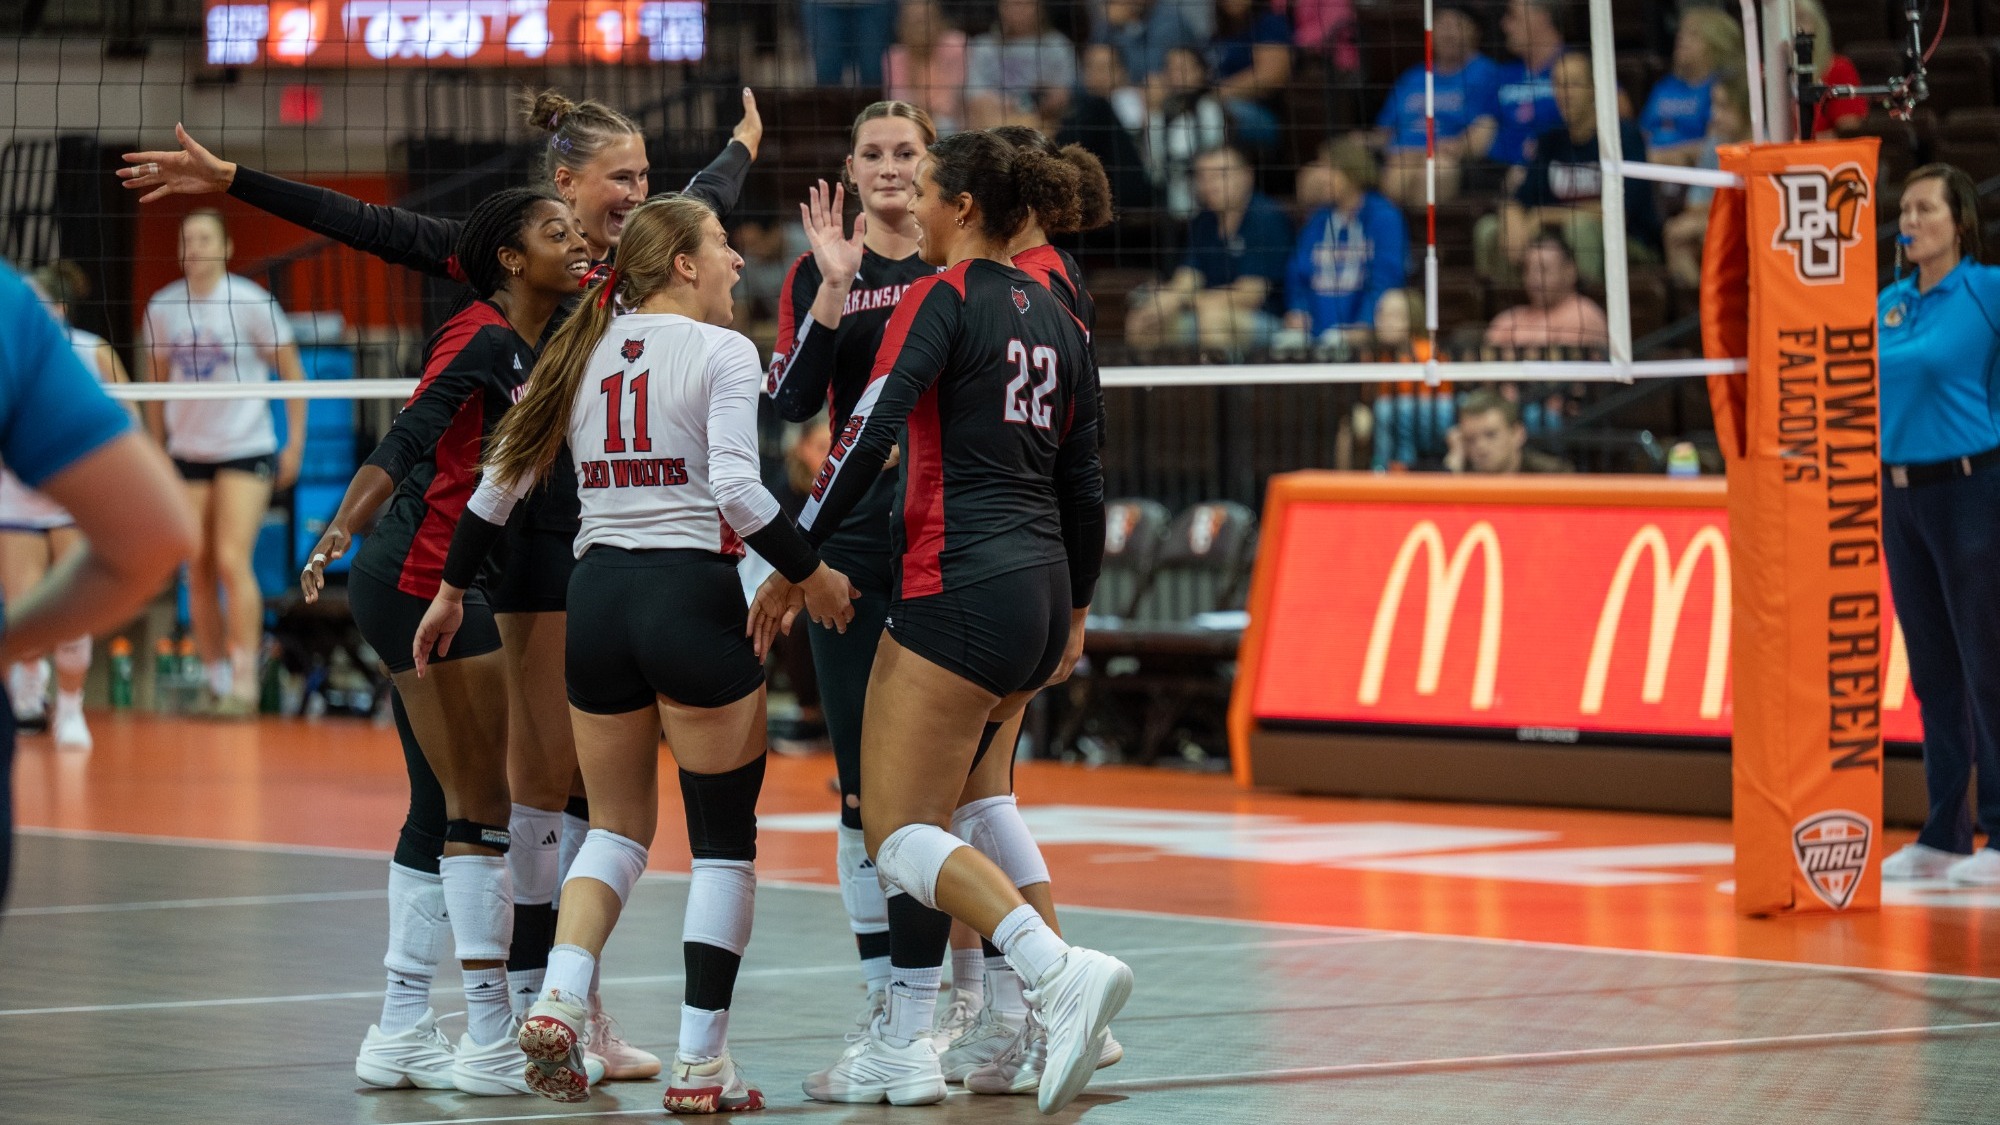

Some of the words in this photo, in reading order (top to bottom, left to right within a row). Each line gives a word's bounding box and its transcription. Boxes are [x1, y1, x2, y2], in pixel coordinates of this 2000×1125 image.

[507, 10, 552, 58] 4
[842, 284, 911, 316] RKANSA
[600, 368, 652, 453] 11
[1003, 337, 1058, 430] 22
[1778, 326, 1820, 482] FALCONS
[581, 460, 611, 489] RED
[611, 457, 689, 488] WOLVES
[1823, 317, 1880, 568] BOWLING
[1827, 592, 1881, 773] GREEN
[1803, 842, 1867, 872] MAC
